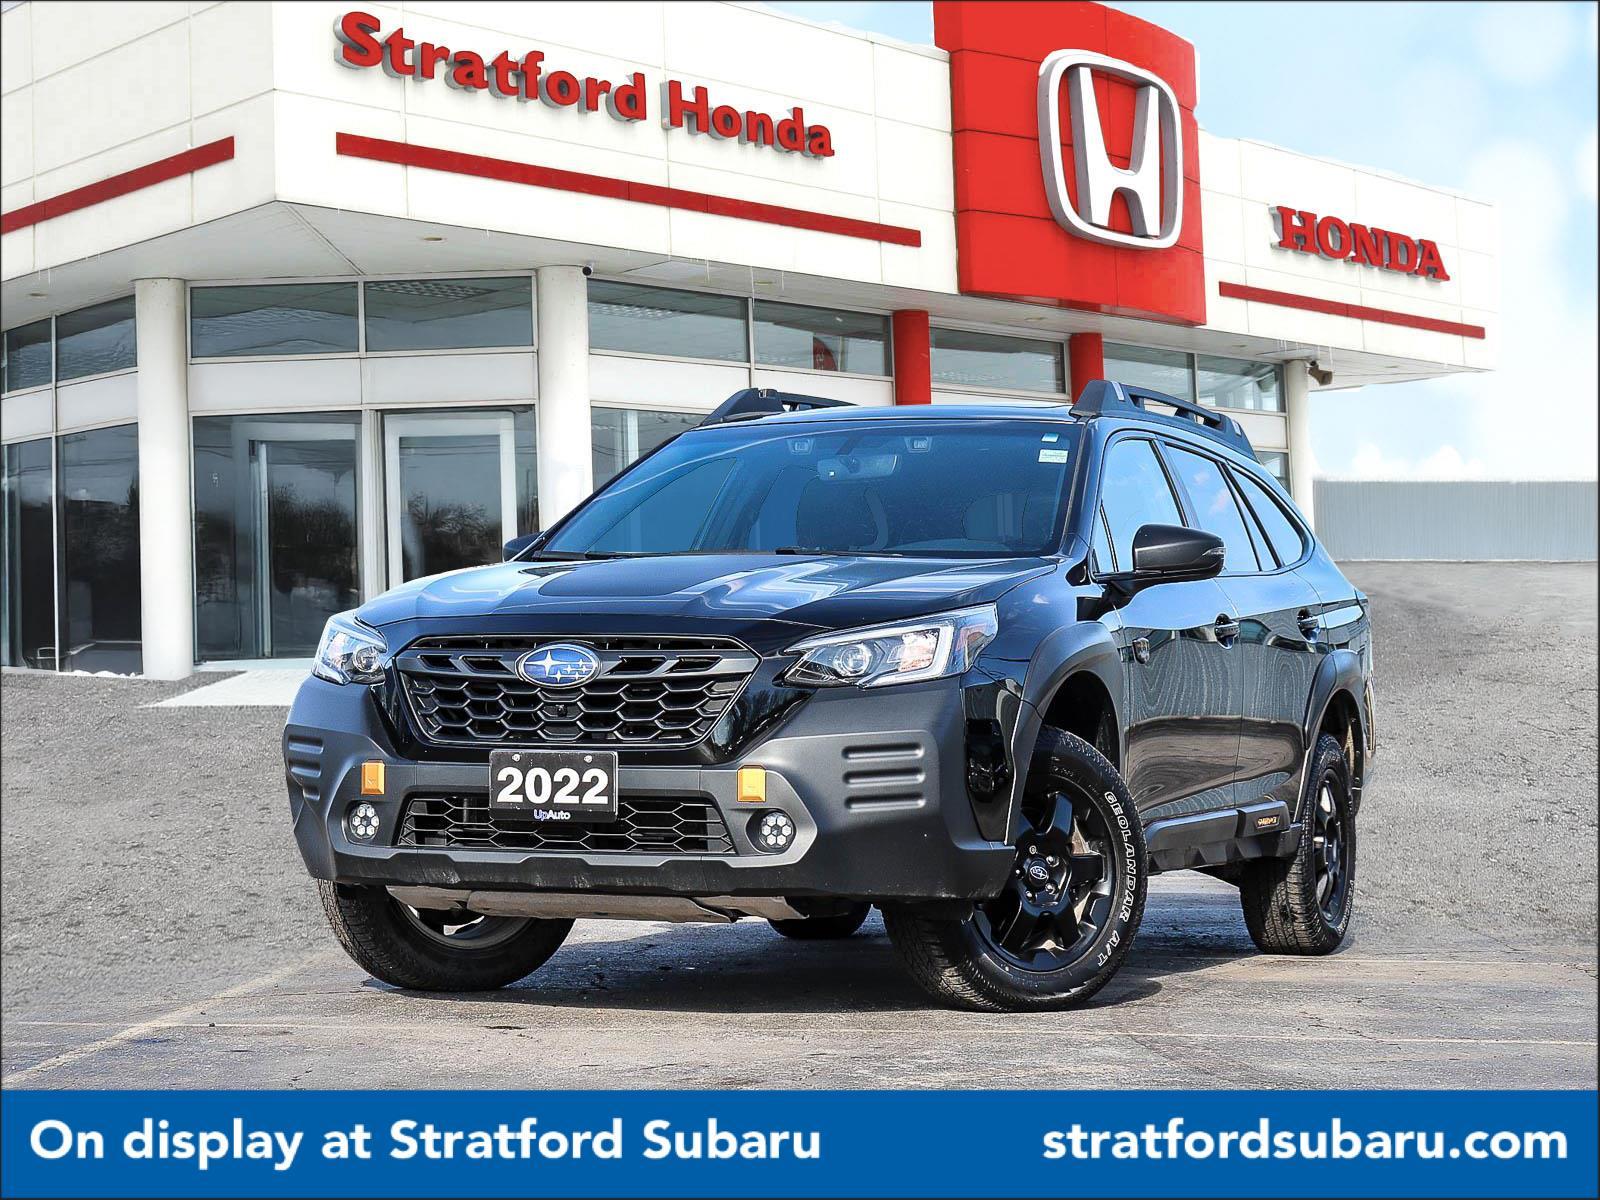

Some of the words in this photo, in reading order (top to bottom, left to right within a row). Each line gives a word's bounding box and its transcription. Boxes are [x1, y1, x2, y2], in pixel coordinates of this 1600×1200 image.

[338, 11, 647, 122] Stratford
[665, 79, 836, 158] Honda
[1272, 205, 1451, 282] HONDA
[496, 766, 609, 804] 2022
[533, 809, 571, 821] UpAuto
[1104, 791, 1136, 923] GEOLANDAR
